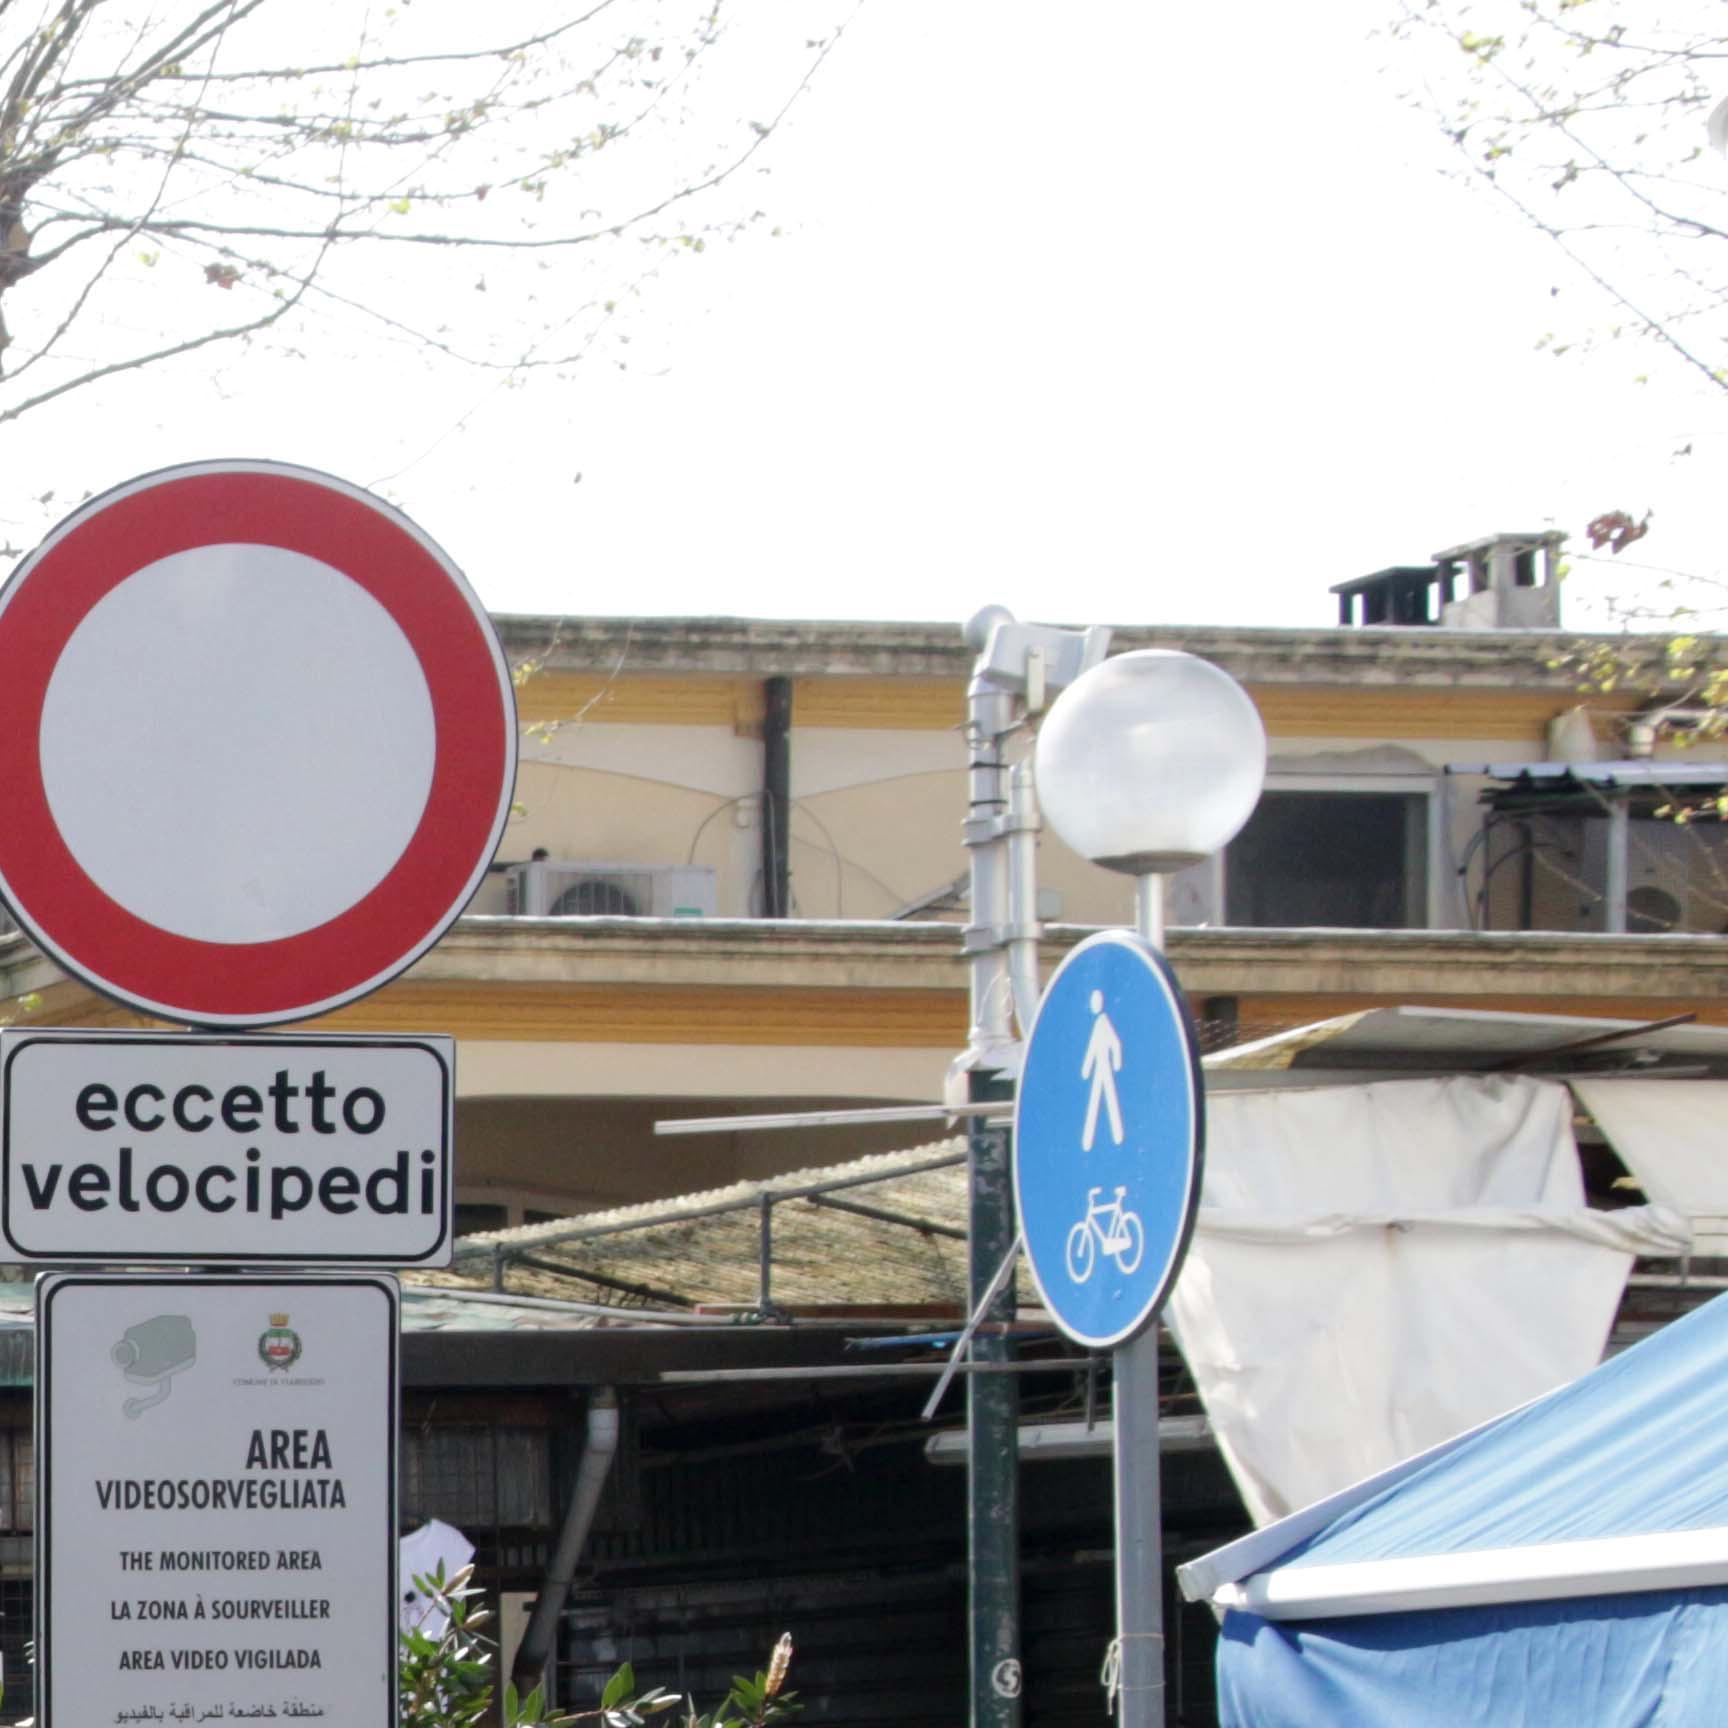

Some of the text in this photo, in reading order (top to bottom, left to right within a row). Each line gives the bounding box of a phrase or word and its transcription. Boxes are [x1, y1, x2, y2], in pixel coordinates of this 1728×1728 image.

[75, 1069, 386, 1135] eccetto
[21, 1146, 436, 1220] velocipedi
[245, 1429, 333, 1470] AREA
[95, 1478, 347, 1510] VIDEOSORVEGLIATA
[120, 1550, 322, 1571] THE MONITORED AREA
[111, 1593, 331, 1620] LA ZONA À SOURVEILLER
[119, 1649, 322, 1670] AREA VIDEO VIGILADA
[228, 1702, 277, 1719] خاضعة
[281, 1699, 325, 1718] منطقة
